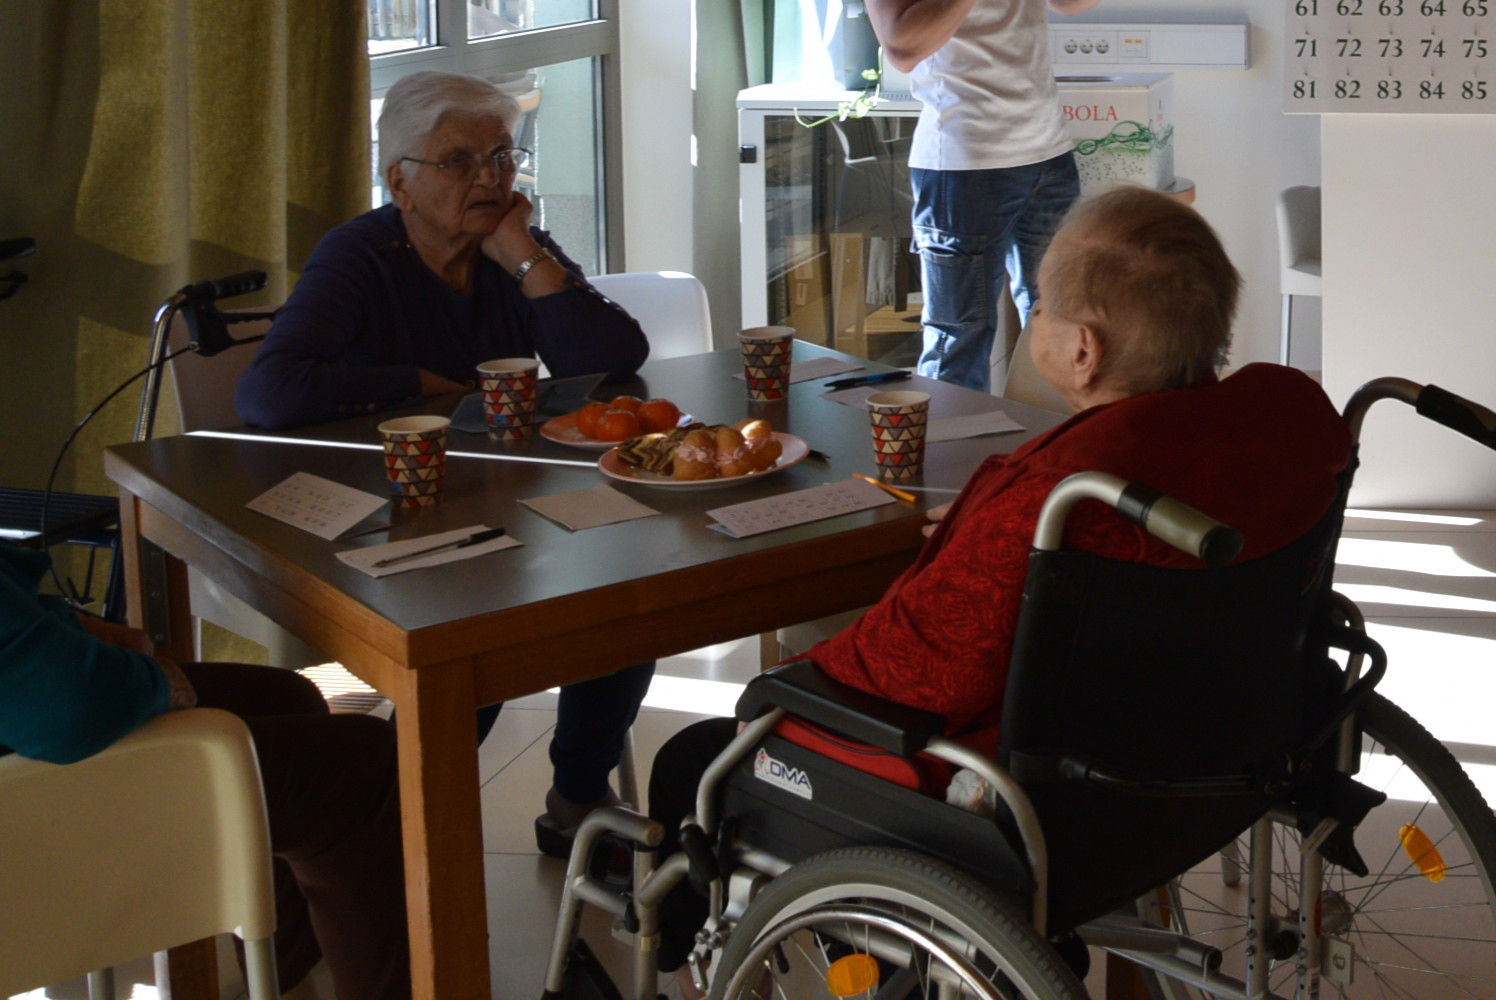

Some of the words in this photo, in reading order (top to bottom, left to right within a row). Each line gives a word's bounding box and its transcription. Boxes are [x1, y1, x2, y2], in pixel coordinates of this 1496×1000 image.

[1294, 38, 1317, 58] 71
[1335, 38, 1362, 58] 72
[1377, 38, 1404, 58] 73
[1420, 38, 1447, 58] 74
[1462, 39, 1488, 59] 75
[1292, 79, 1316, 99] 81
[1334, 79, 1361, 99] 82
[1376, 79, 1403, 100] 83
[1418, 80, 1446, 100] 84
[1461, 80, 1488, 100] 85
[1062, 105, 1119, 121] BOLA
[769, 760, 811, 790] DMA
